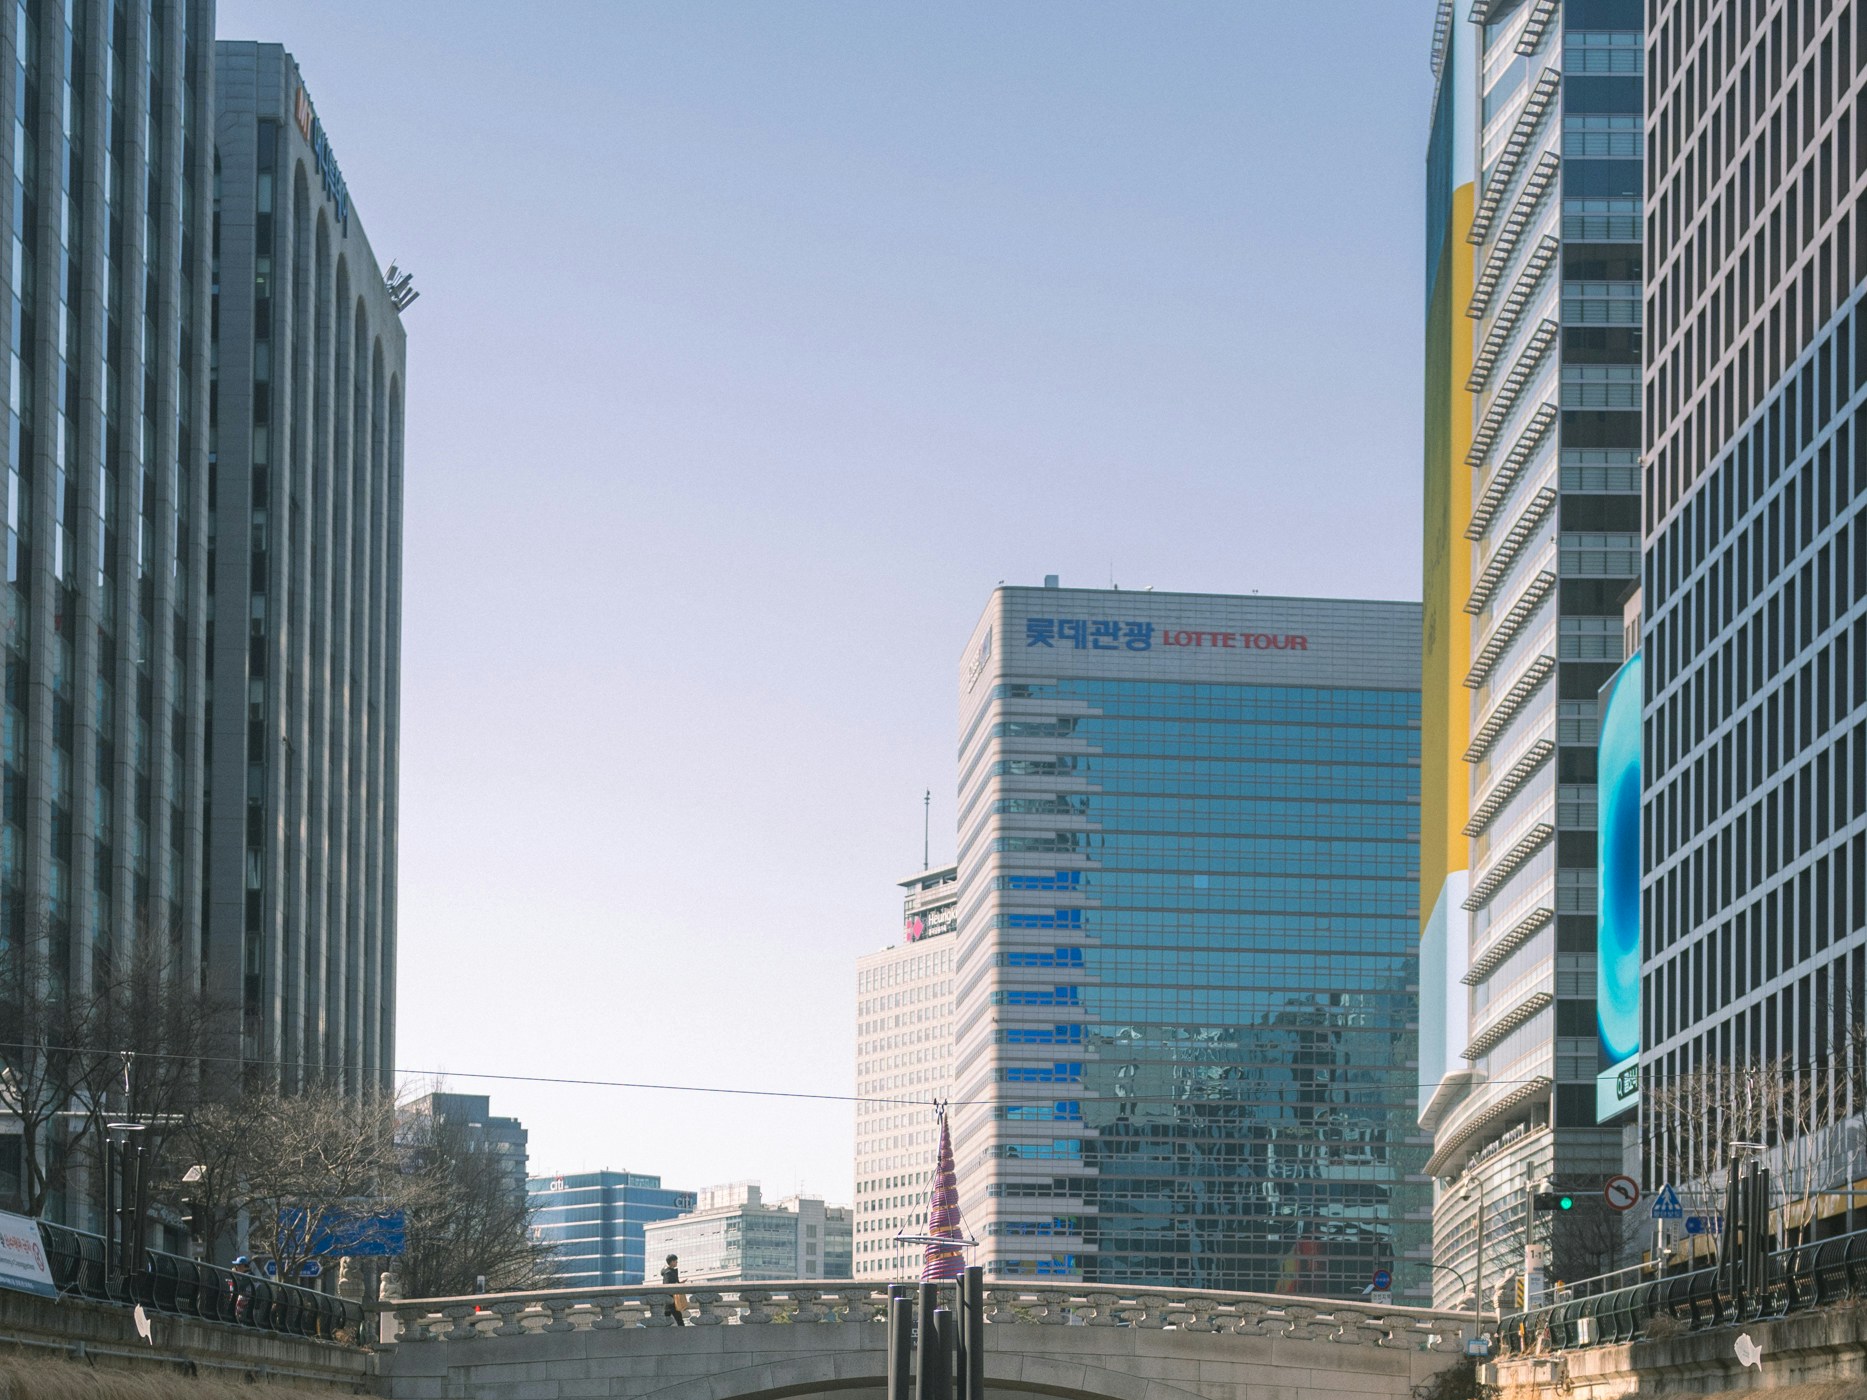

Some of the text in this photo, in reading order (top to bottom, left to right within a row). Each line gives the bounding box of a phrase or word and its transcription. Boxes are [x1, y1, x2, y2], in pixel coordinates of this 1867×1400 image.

[1026, 617, 1308, 652] 롯데관광 LOTTE TOUR
[550, 1178, 564, 1191] citi
[675, 1195, 693, 1209] citi
[1531, 1250, 1542, 1260] 1-1
